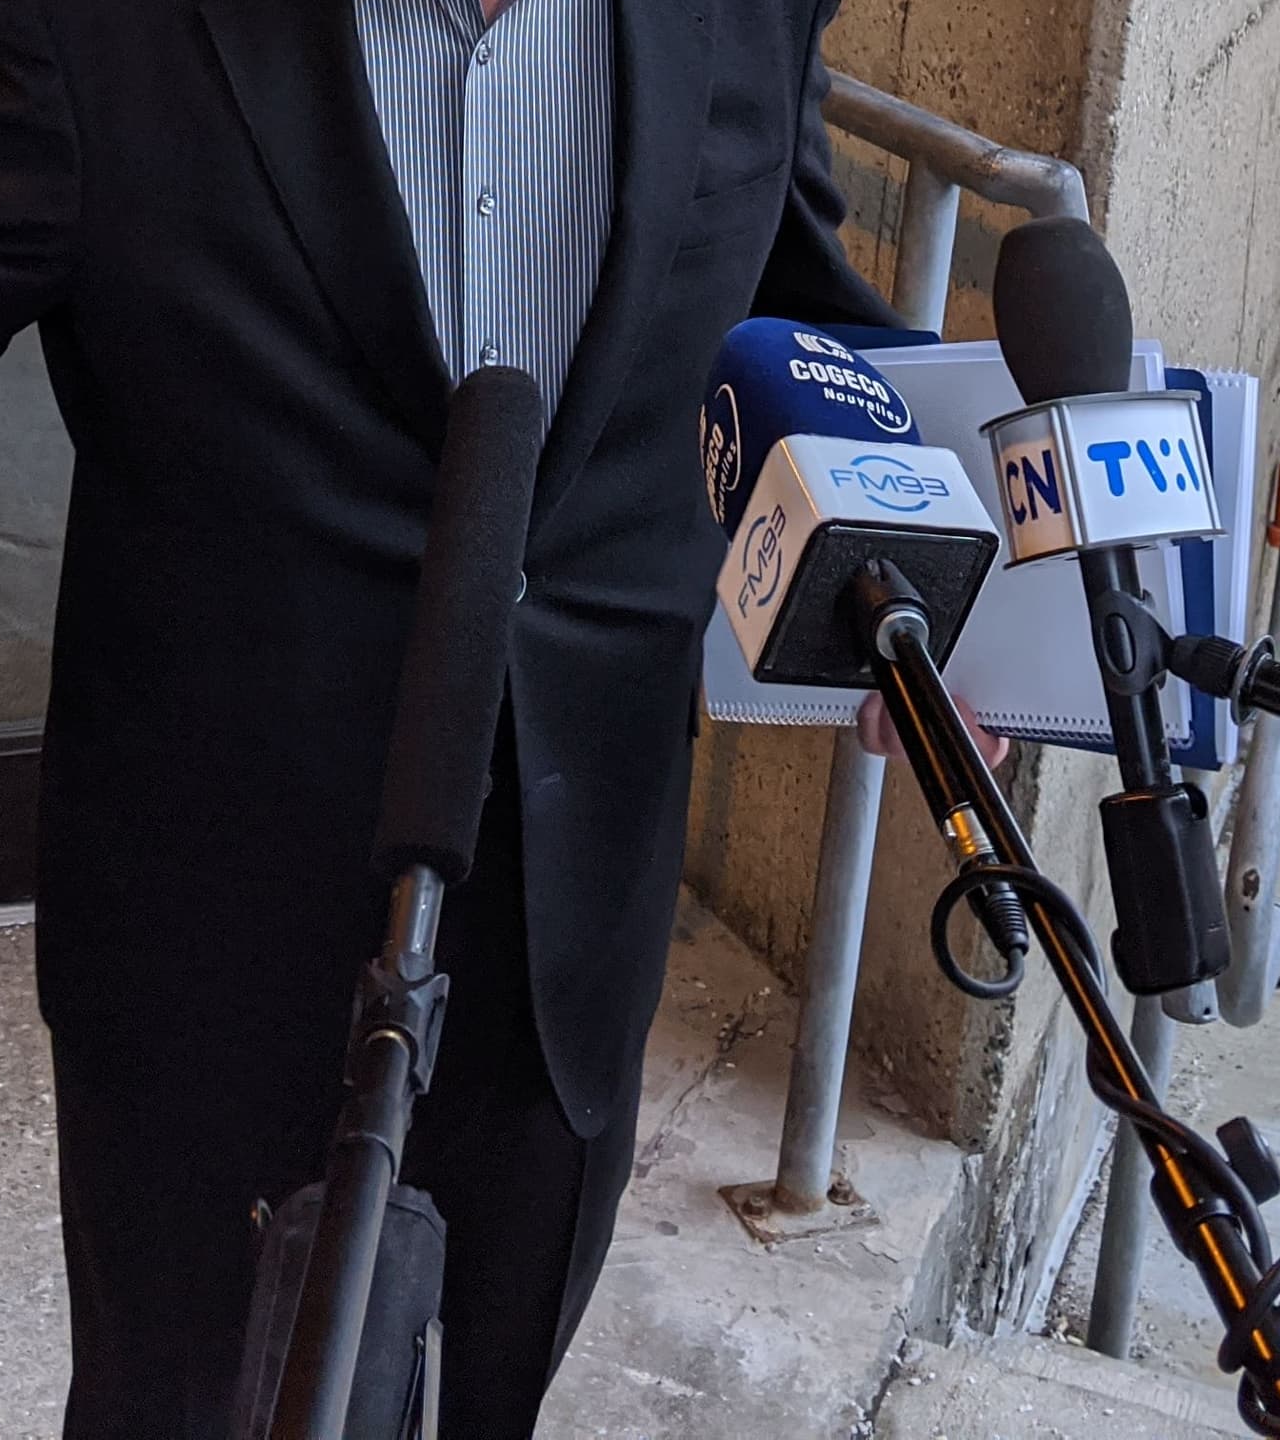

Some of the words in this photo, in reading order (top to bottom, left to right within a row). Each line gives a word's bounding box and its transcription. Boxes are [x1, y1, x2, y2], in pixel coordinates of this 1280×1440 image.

[789, 359, 890, 404] COGECO
[824, 386, 903, 426] Nouvelles
[829, 468, 950, 498] FM93
[737, 503, 788, 619] FM93
